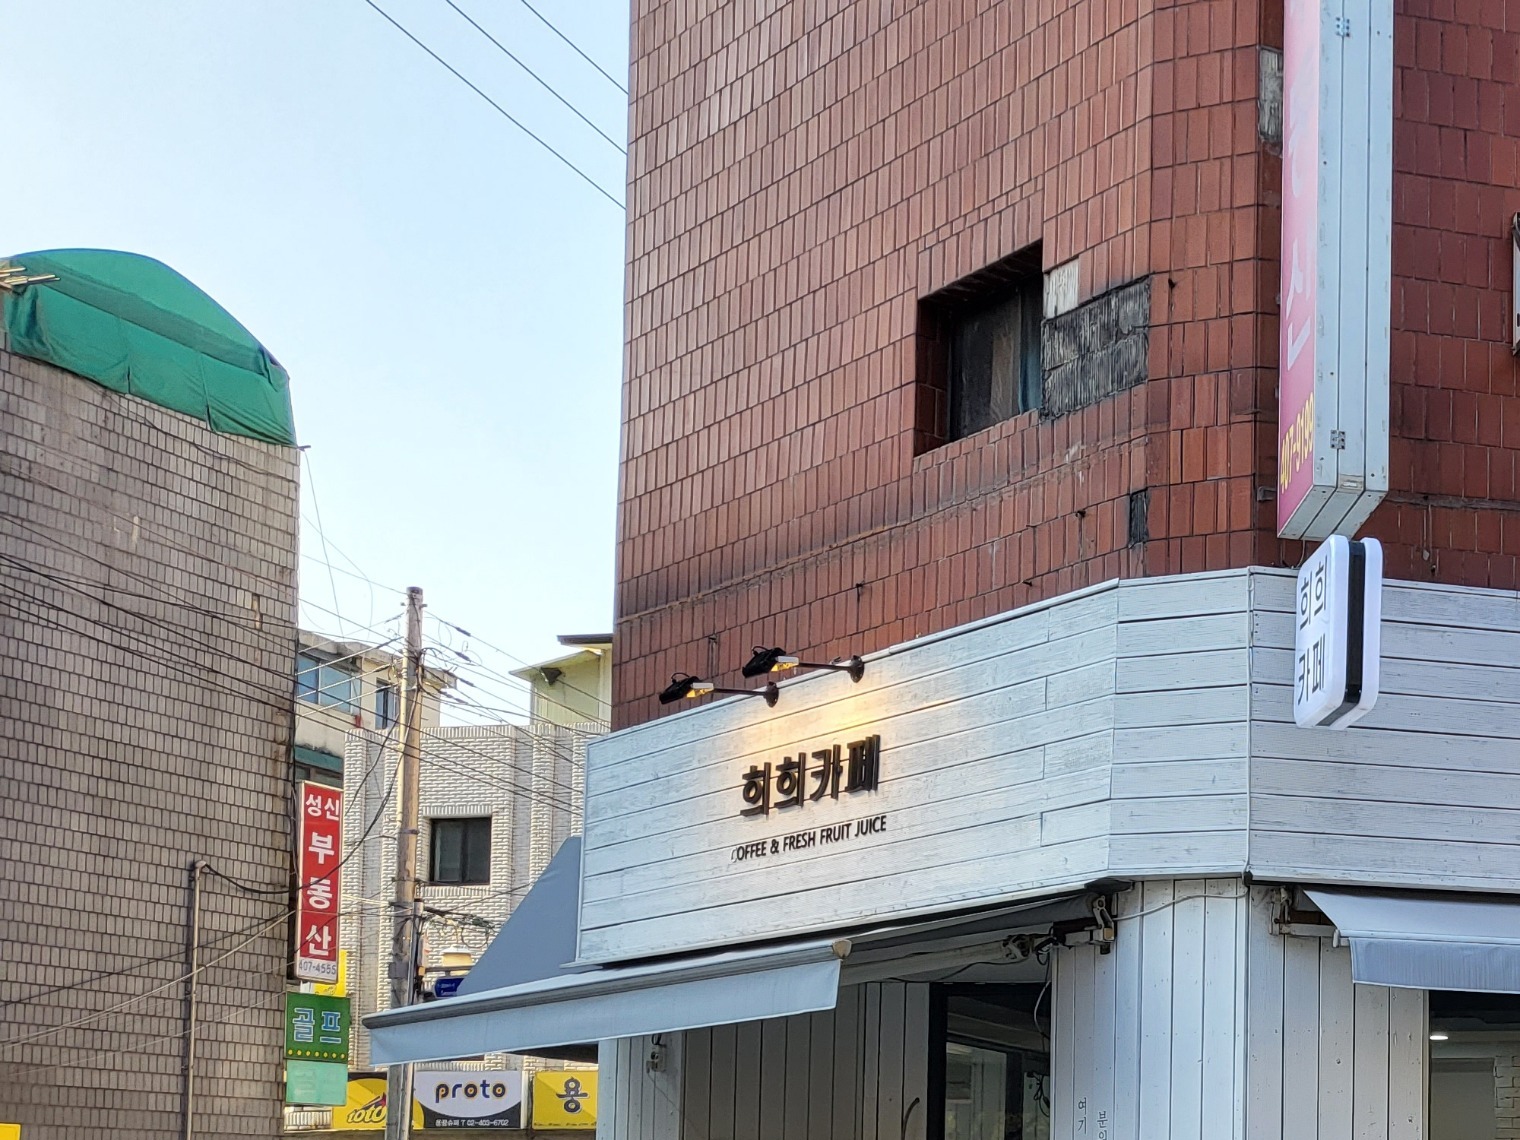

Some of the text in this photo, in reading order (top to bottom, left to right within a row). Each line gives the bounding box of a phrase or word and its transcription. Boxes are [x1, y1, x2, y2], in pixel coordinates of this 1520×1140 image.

[1280, 391, 1314, 494] 407-9199
[1300, 556, 1328, 631] 희희
[1298, 633, 1326, 706] 카페
[740, 734, 881, 817] 희희카페
[306, 794, 340, 821] 성신
[770, 839, 779, 854] &
[783, 829, 816, 851] FRESH
[819, 822, 852, 845] FRUIT
[855, 815, 887, 838] JUICE
[308, 831, 335, 957] 부동산
[293, 1007, 341, 1043] 골프
[435, 1080, 506, 1103] proto
[1077, 1097, 1087, 1135] 여기
